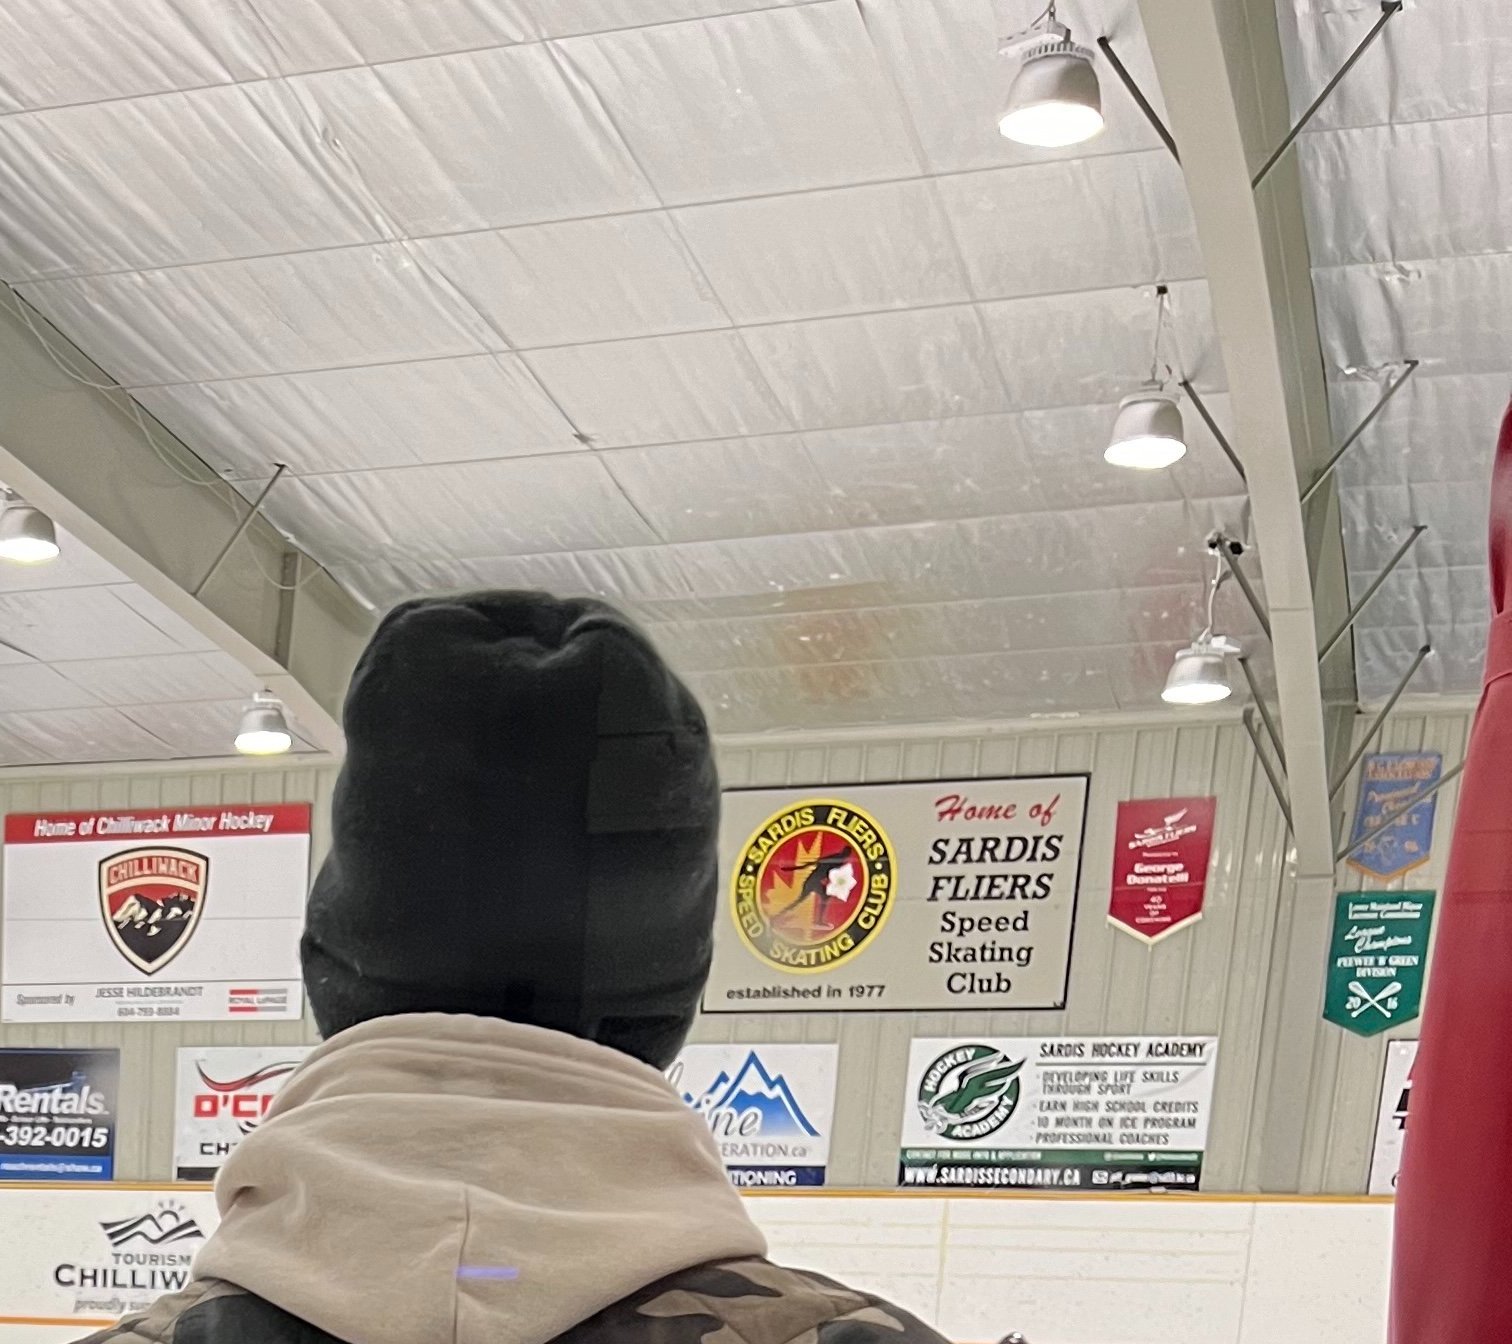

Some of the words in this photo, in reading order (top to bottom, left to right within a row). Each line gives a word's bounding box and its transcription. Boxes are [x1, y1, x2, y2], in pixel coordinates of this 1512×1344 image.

[934, 794, 1017, 822] Home
[1028, 793, 1061, 827] of
[34, 819, 76, 837] Home
[78, 817, 95, 836] of
[96, 815, 170, 835] Chilliwack
[172, 813, 217, 832] Minor
[218, 811, 274, 833] Hockey
[748, 807, 816, 864] SARDIS
[826, 807, 885, 861] FLIERS
[927, 834, 1064, 865] SARDIS
[109, 857, 199, 885] CHILLIWACK
[1126, 872, 1189, 885] Donatelli
[1134, 863, 1184, 874] George
[926, 873, 1054, 902] FLIERS
[737, 873, 764, 938] SPEED
[769, 932, 855, 966] SKATING
[857, 873, 889, 930] CLUB
[941, 910, 1029, 937] Speed
[928, 940, 1034, 967] Skating
[96, 986, 124, 998] JESSE
[726, 985, 822, 1000] established
[826, 985, 842, 998] in
[849, 984, 886, 998] 1977
[947, 972, 1012, 995] Club
[1039, 1042, 1086, 1058] SARDIS
[1091, 1041, 1141, 1058] HOCKEY
[1146, 1041, 1207, 1058] ACADEMY
[924, 1049, 976, 1093] HOCKEY
[1141, 1070, 1180, 1084] SKILLS
[951, 1094, 1014, 1138] ACADEMY
[1153, 1101, 1199, 1113] CREDITS
[1143, 1117, 1197, 1129] PROGRAM
[904, 1166, 1082, 1187] WWW.SARDISSECONDARY.CA
